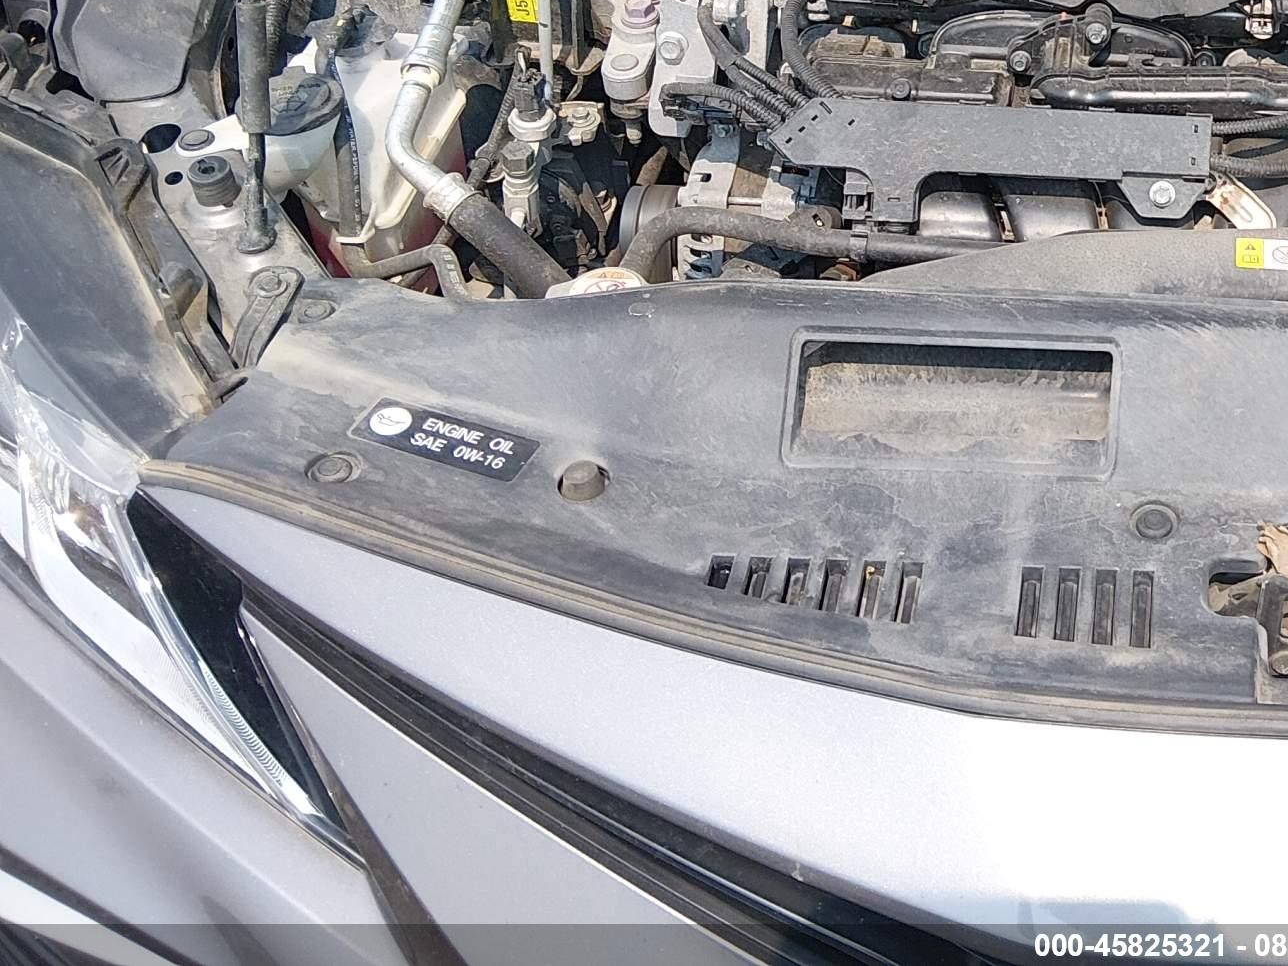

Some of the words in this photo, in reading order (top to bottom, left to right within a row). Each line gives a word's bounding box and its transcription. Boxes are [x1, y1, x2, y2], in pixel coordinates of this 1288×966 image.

[515, 0, 530, 16] J5
[410, 432, 448, 452] SAE
[453, 446, 506, 470] 0W-16
[422, 417, 485, 444] ENGINE
[488, 437, 514, 455] OIL
